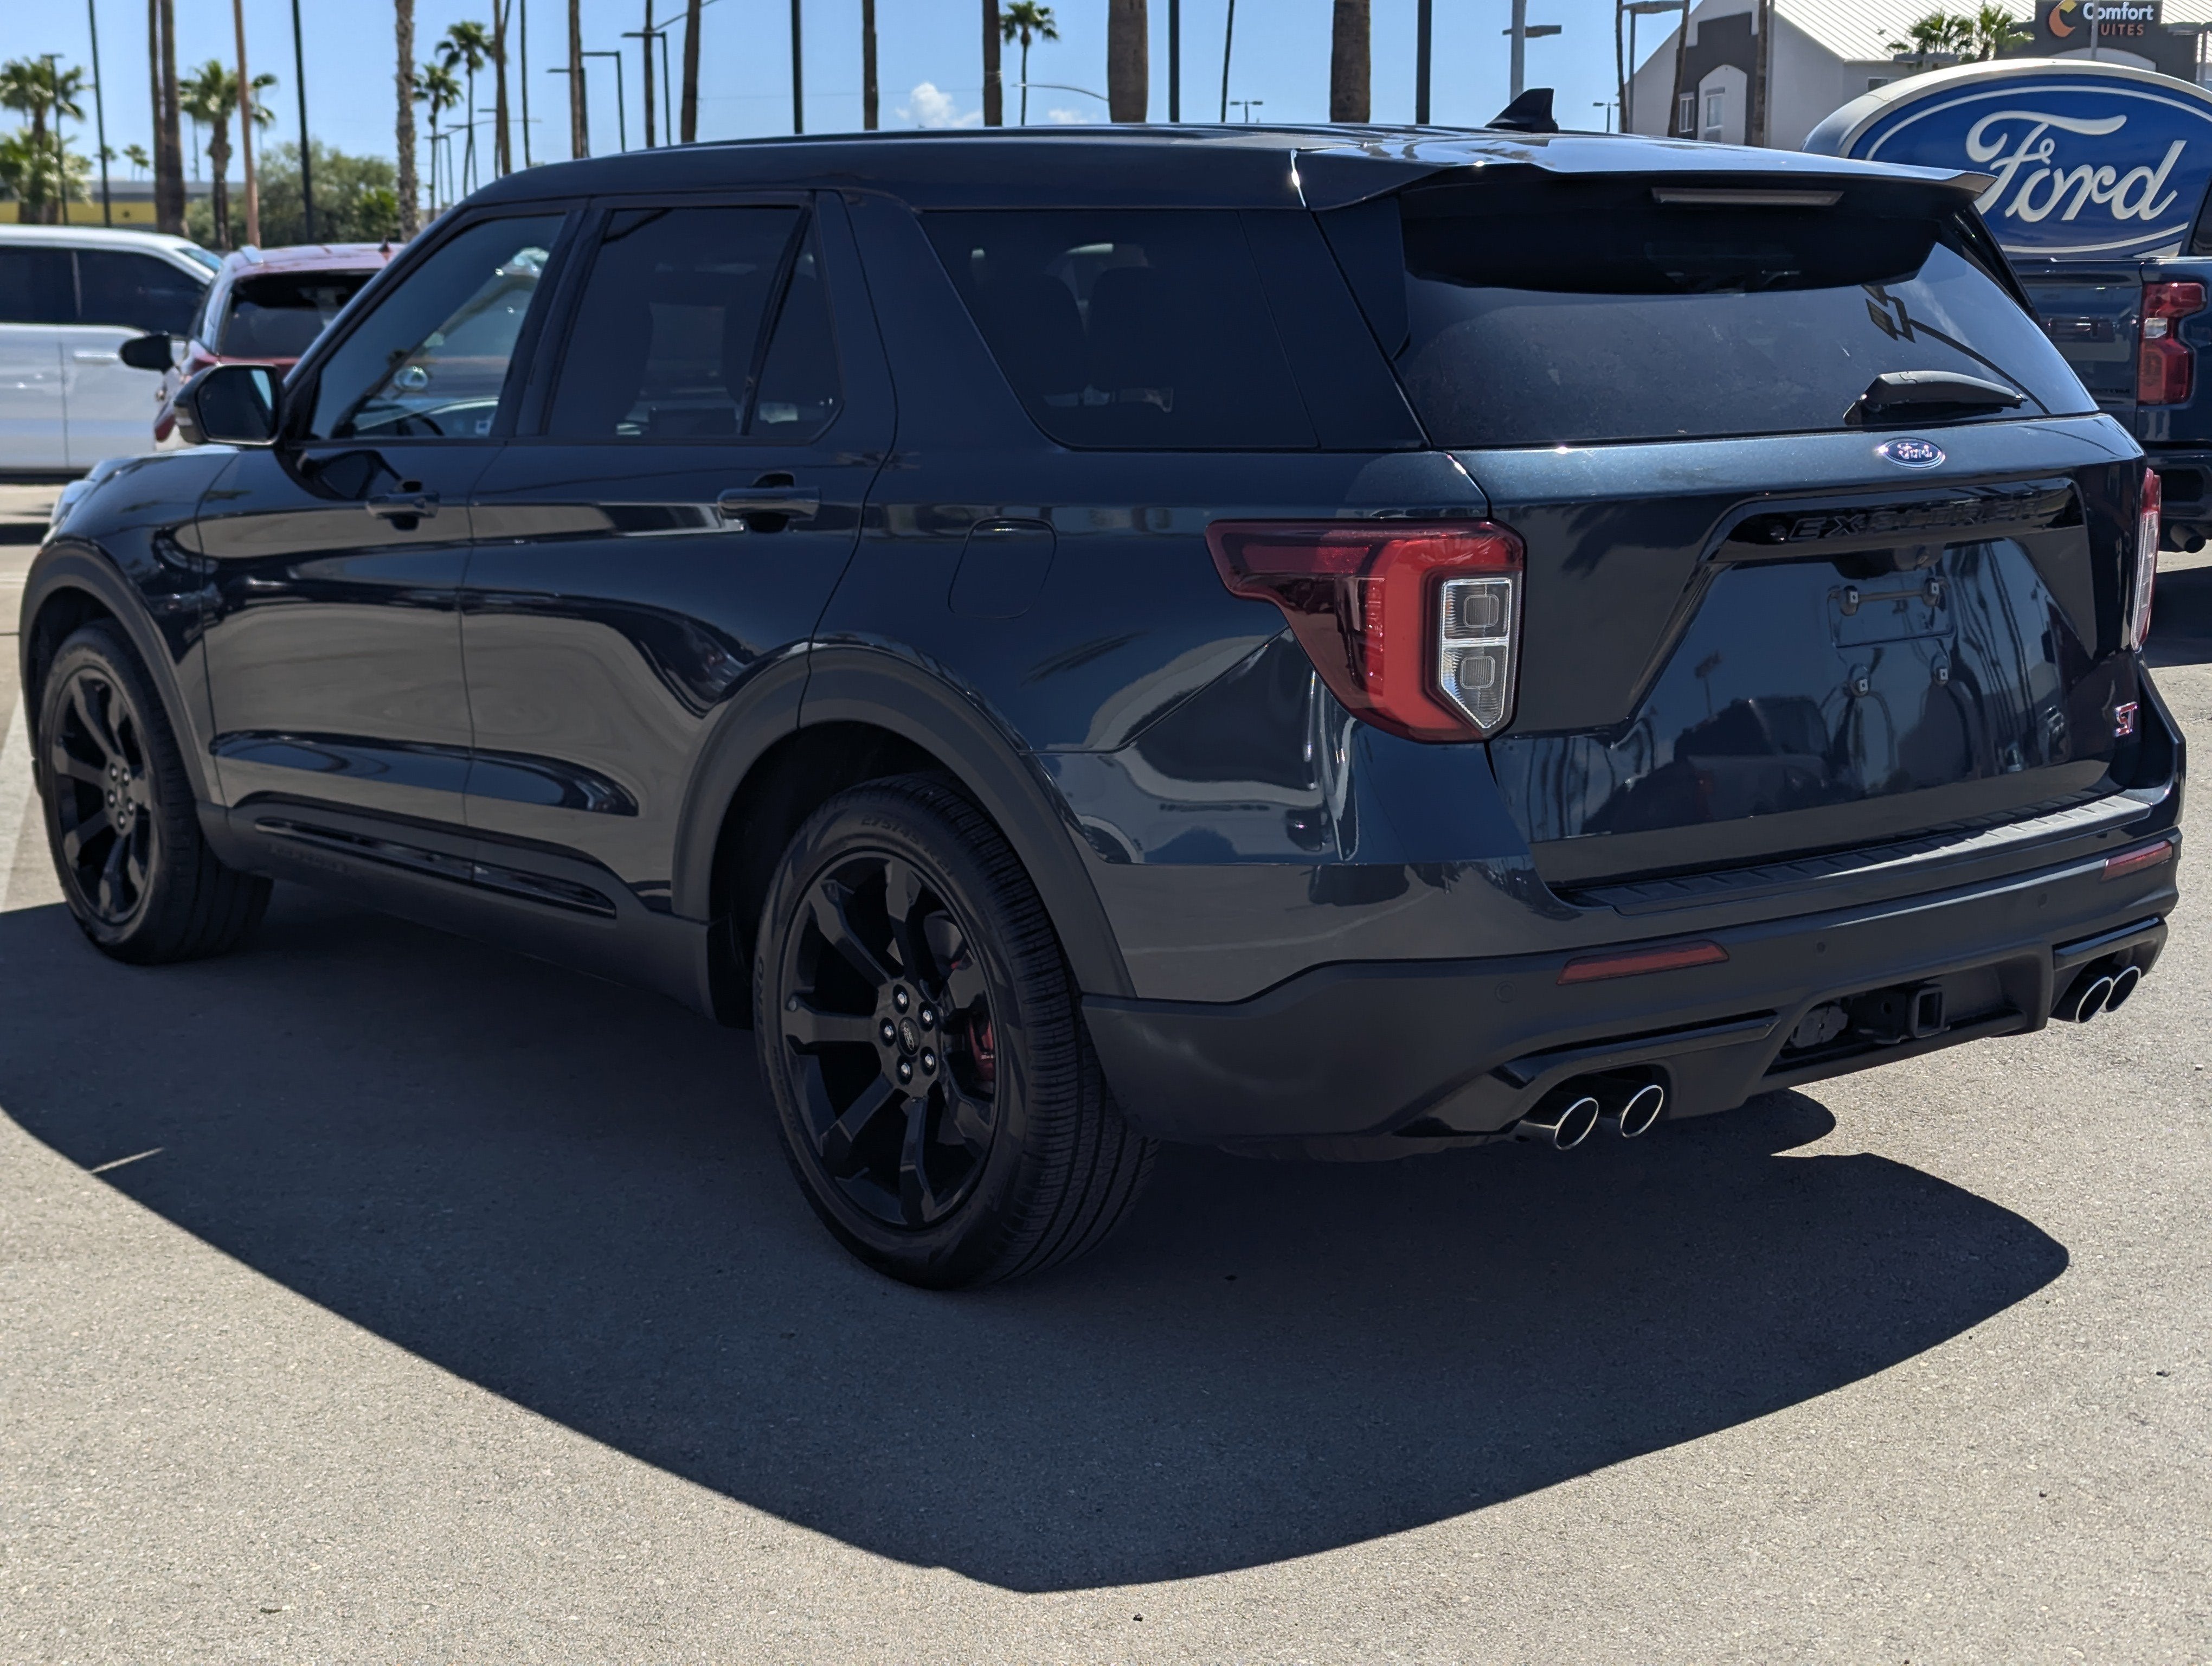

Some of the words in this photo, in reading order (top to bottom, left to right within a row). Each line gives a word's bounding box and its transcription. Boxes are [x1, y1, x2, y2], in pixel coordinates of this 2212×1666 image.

[2083, 2, 2154, 21] Comfort
[2100, 23, 2144, 36] UITES
[1966, 110, 2187, 223] Ford
[1897, 443, 1932, 459] Ford
